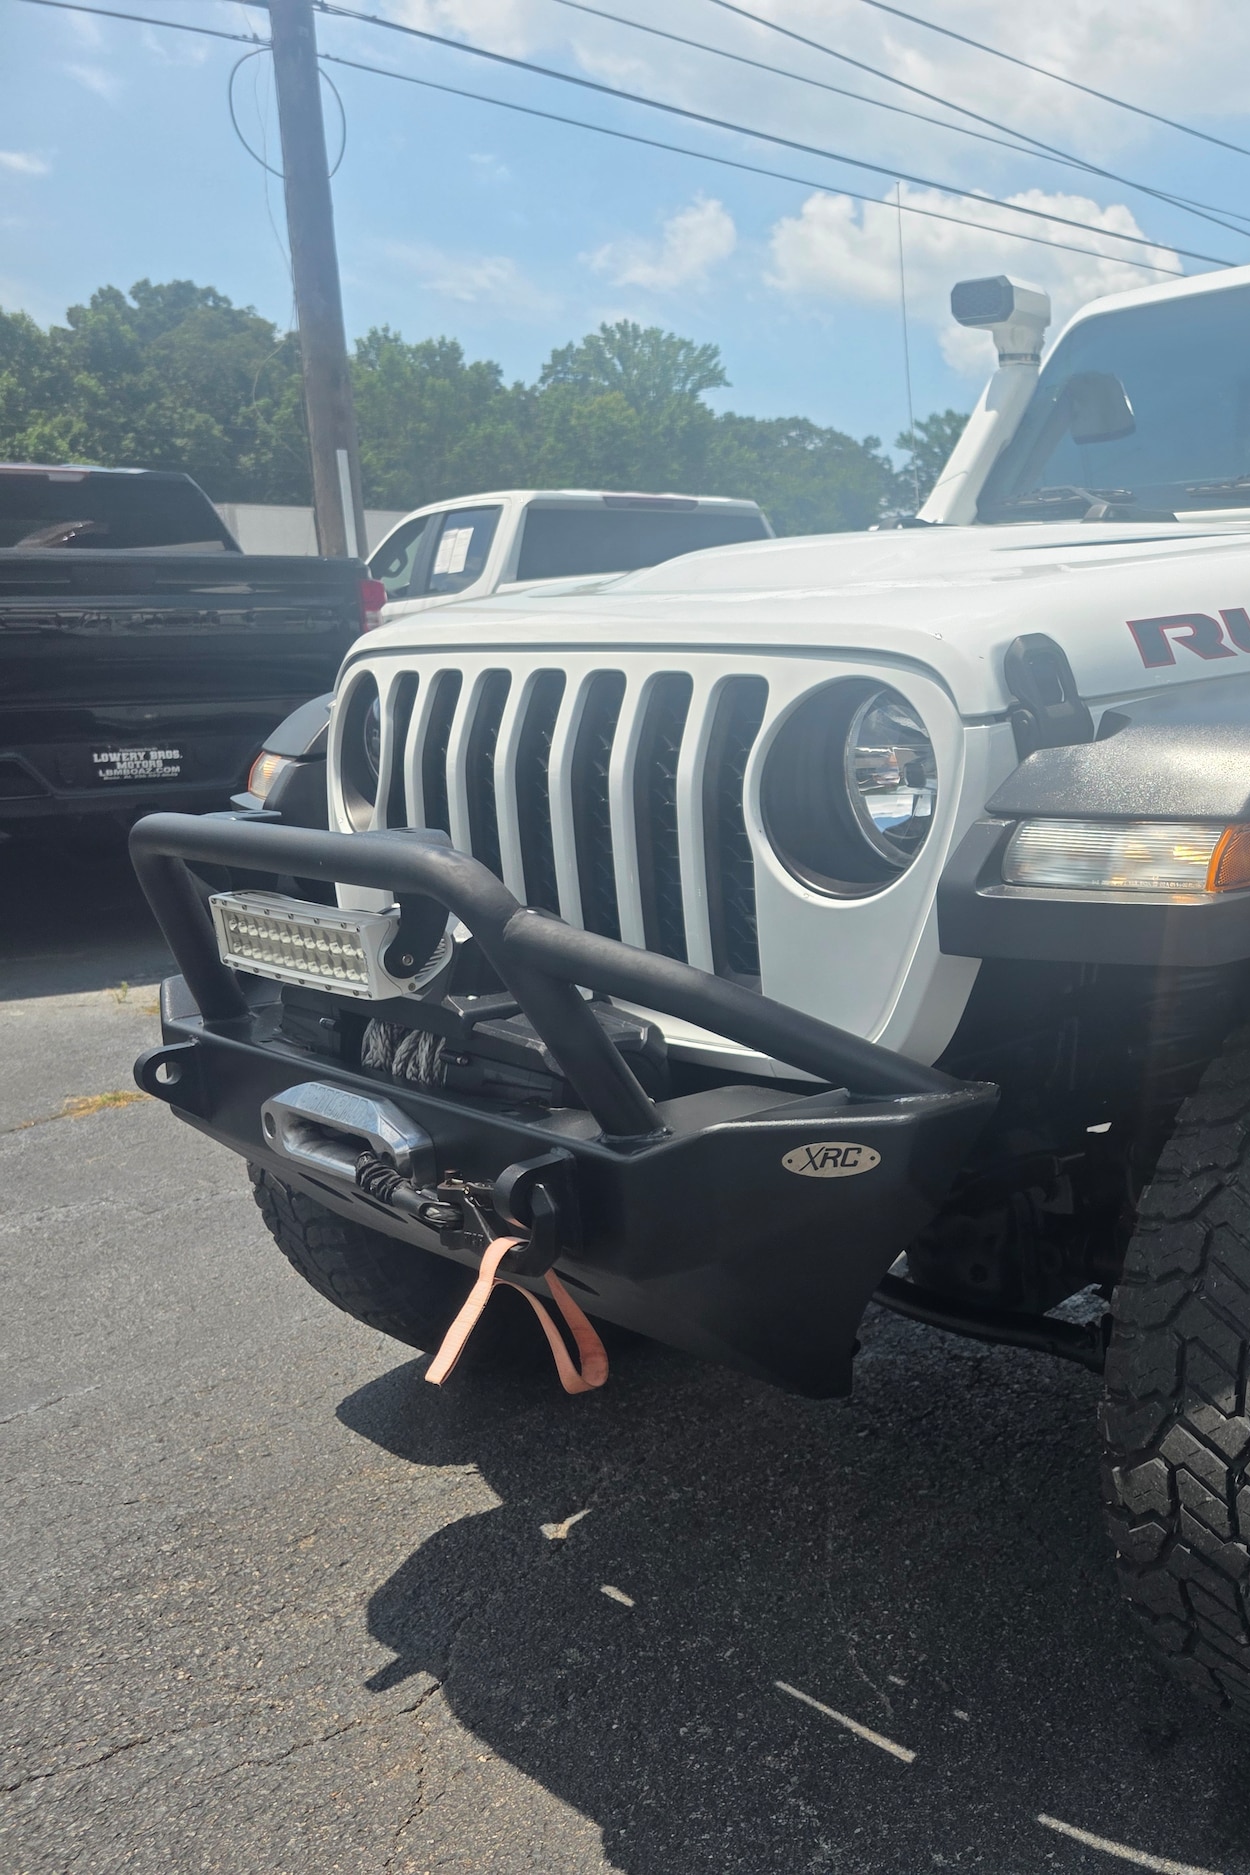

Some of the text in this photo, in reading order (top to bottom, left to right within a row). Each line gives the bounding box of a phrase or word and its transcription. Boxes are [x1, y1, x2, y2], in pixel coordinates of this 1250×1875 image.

[93, 752, 146, 763] LOWERY
[116, 760, 163, 770] MOTORS
[799, 1146, 862, 1171] XRC
